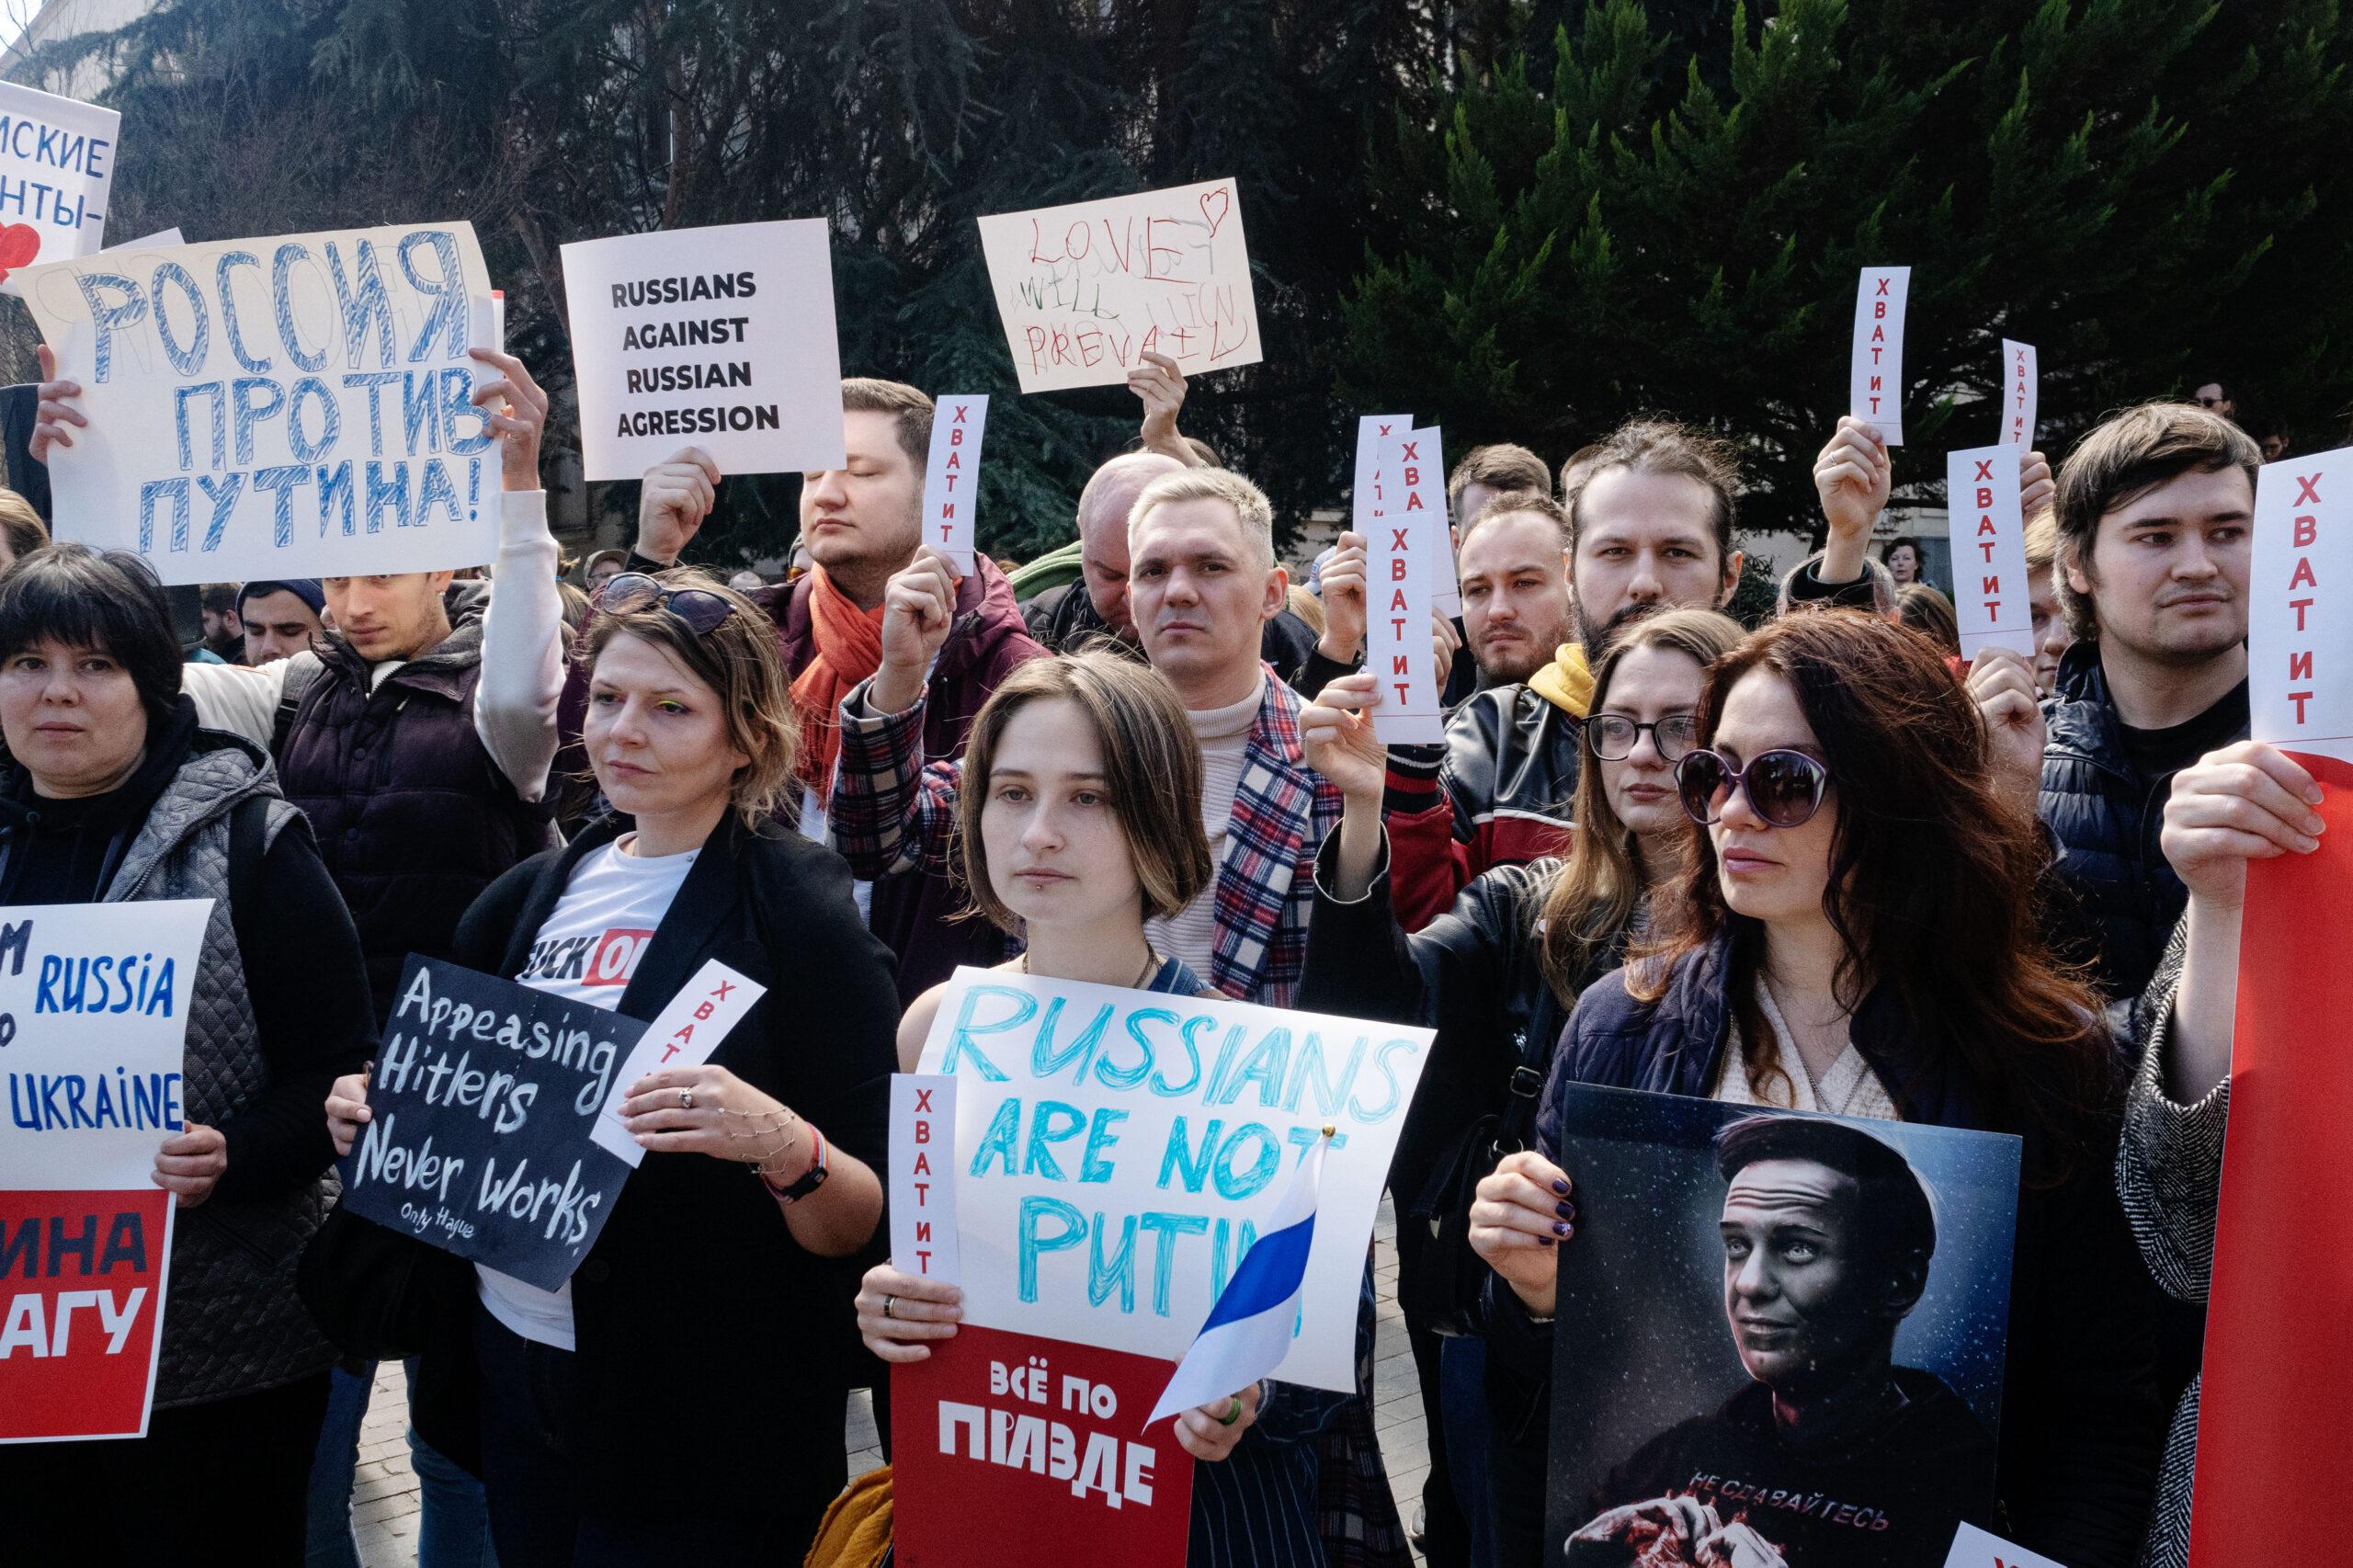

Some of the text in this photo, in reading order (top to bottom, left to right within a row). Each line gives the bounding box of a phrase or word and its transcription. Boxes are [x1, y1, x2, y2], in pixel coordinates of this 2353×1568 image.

[611, 272, 756, 308] RUSSIANS
[1031, 215, 1198, 284] LOVE
[75, 231, 470, 384] РОССИЯ
[622, 317, 749, 351] AGAINST
[1020, 277, 1120, 319] WILL
[626, 362, 752, 394] RUSSIAN
[1026, 318, 1248, 375] PREVAIL
[1869, 278, 1890, 415] ХВАТИТ
[174, 368, 494, 472] ПРОТИВ
[617, 404, 780, 438] AGRESSION
[2014, 349, 2026, 443] ХВАТИТ
[139, 458, 482, 552] ПУТИНА!
[940, 406, 968, 542] ХВАТИТ
[1974, 460, 2001, 622] ХВАТИТ
[1390, 528, 1411, 706] ХВАТИТ
[2286, 472, 2324, 724] ХВАТИТ
[396, 966, 618, 1117] Appeasing
[646, 980, 736, 1076] ХВАТ
[941, 984, 1418, 1125] RUSSIANS
[353, 1112, 601, 1246] Never Works
[914, 1088, 933, 1274] ХВАТИТ
[968, 1096, 1131, 1184] ARE
[401, 1202, 475, 1239] Only Hague
[990, 1356, 1118, 1419] ВСЁ ПО
[938, 1399, 1156, 1510] ПРАВДЕ
[1689, 1471, 1720, 1491] НЕ
